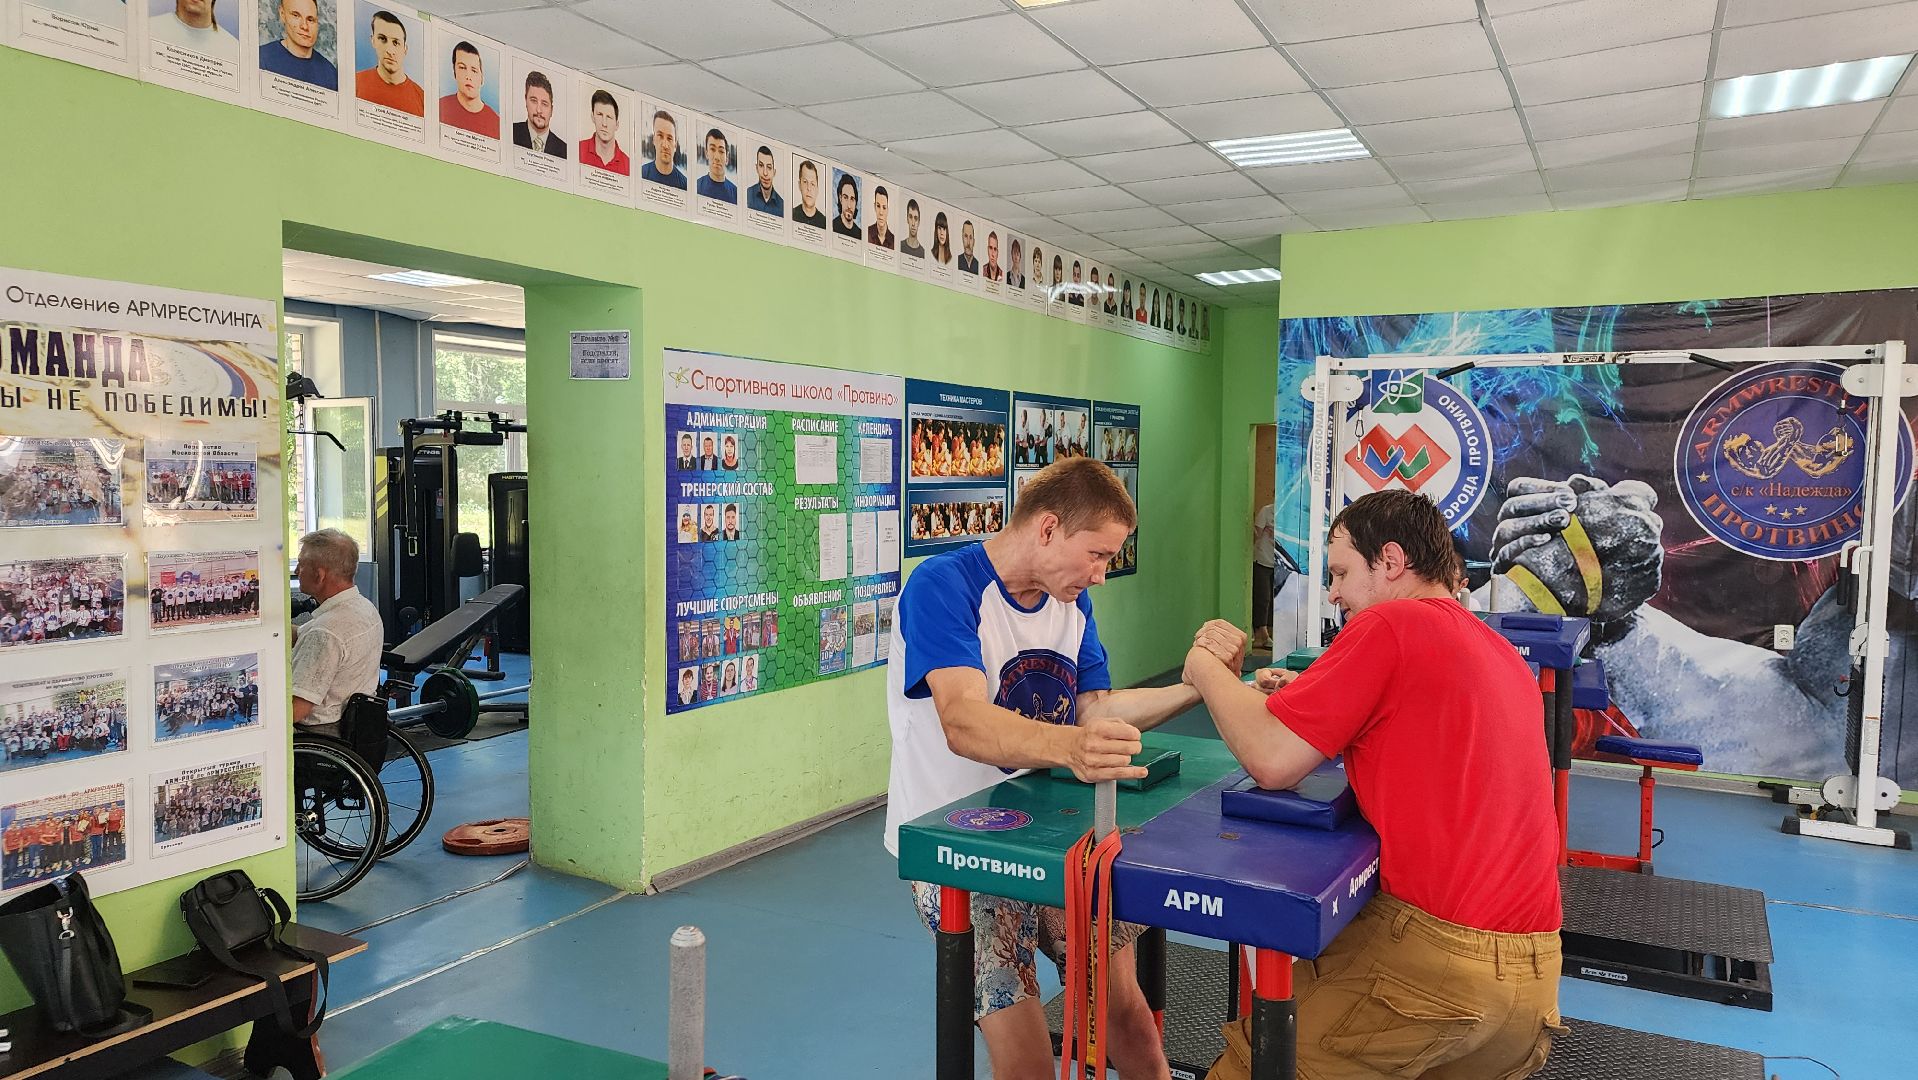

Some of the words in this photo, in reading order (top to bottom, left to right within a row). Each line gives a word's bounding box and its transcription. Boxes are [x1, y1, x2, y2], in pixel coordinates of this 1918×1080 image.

[6, 285, 120, 314] Отделение
[127, 299, 262, 329] АРМРЕСТЛИНГА
[0, 327, 151, 388] МАНДА
[691, 369, 786, 398] Спортивная
[791, 383, 833, 401] школа
[837, 384, 899, 407] «Протвино»
[47, 388, 82, 411] НЕ
[104, 391, 268, 419] ПОБЕДИМЫ!
[686, 411, 767, 430] АДМИНИСТРАЦИЯ
[792, 418, 839, 433] РАСПИСАНИЕ
[858, 422, 893, 436] КАЛЕНДАРЬ
[1438, 395, 1481, 466] ПРОТВИНО
[681, 481, 741, 497] ТРЕНЕРСКИЙ
[742, 482, 774, 496] СОСТАВ
[1443, 475, 1479, 520] ОРОДА
[1730, 482, 1755, 498] с/к
[1759, 481, 1853, 500] «Надежда»
[794, 496, 839, 510] РЕЗУЛЬТАТЫ
[793, 589, 842, 608] ОБЪЯВЛЕНИЯ
[854, 581, 897, 599] ПОЗДРАВЛЯЕМ
[675, 598, 719, 617] ЛУЧШИЕ
[720, 591, 779, 610] СПОРТСМЕНЫ
[936, 845, 1046, 881] Протвино
[1163, 888, 1224, 918] АРМ
